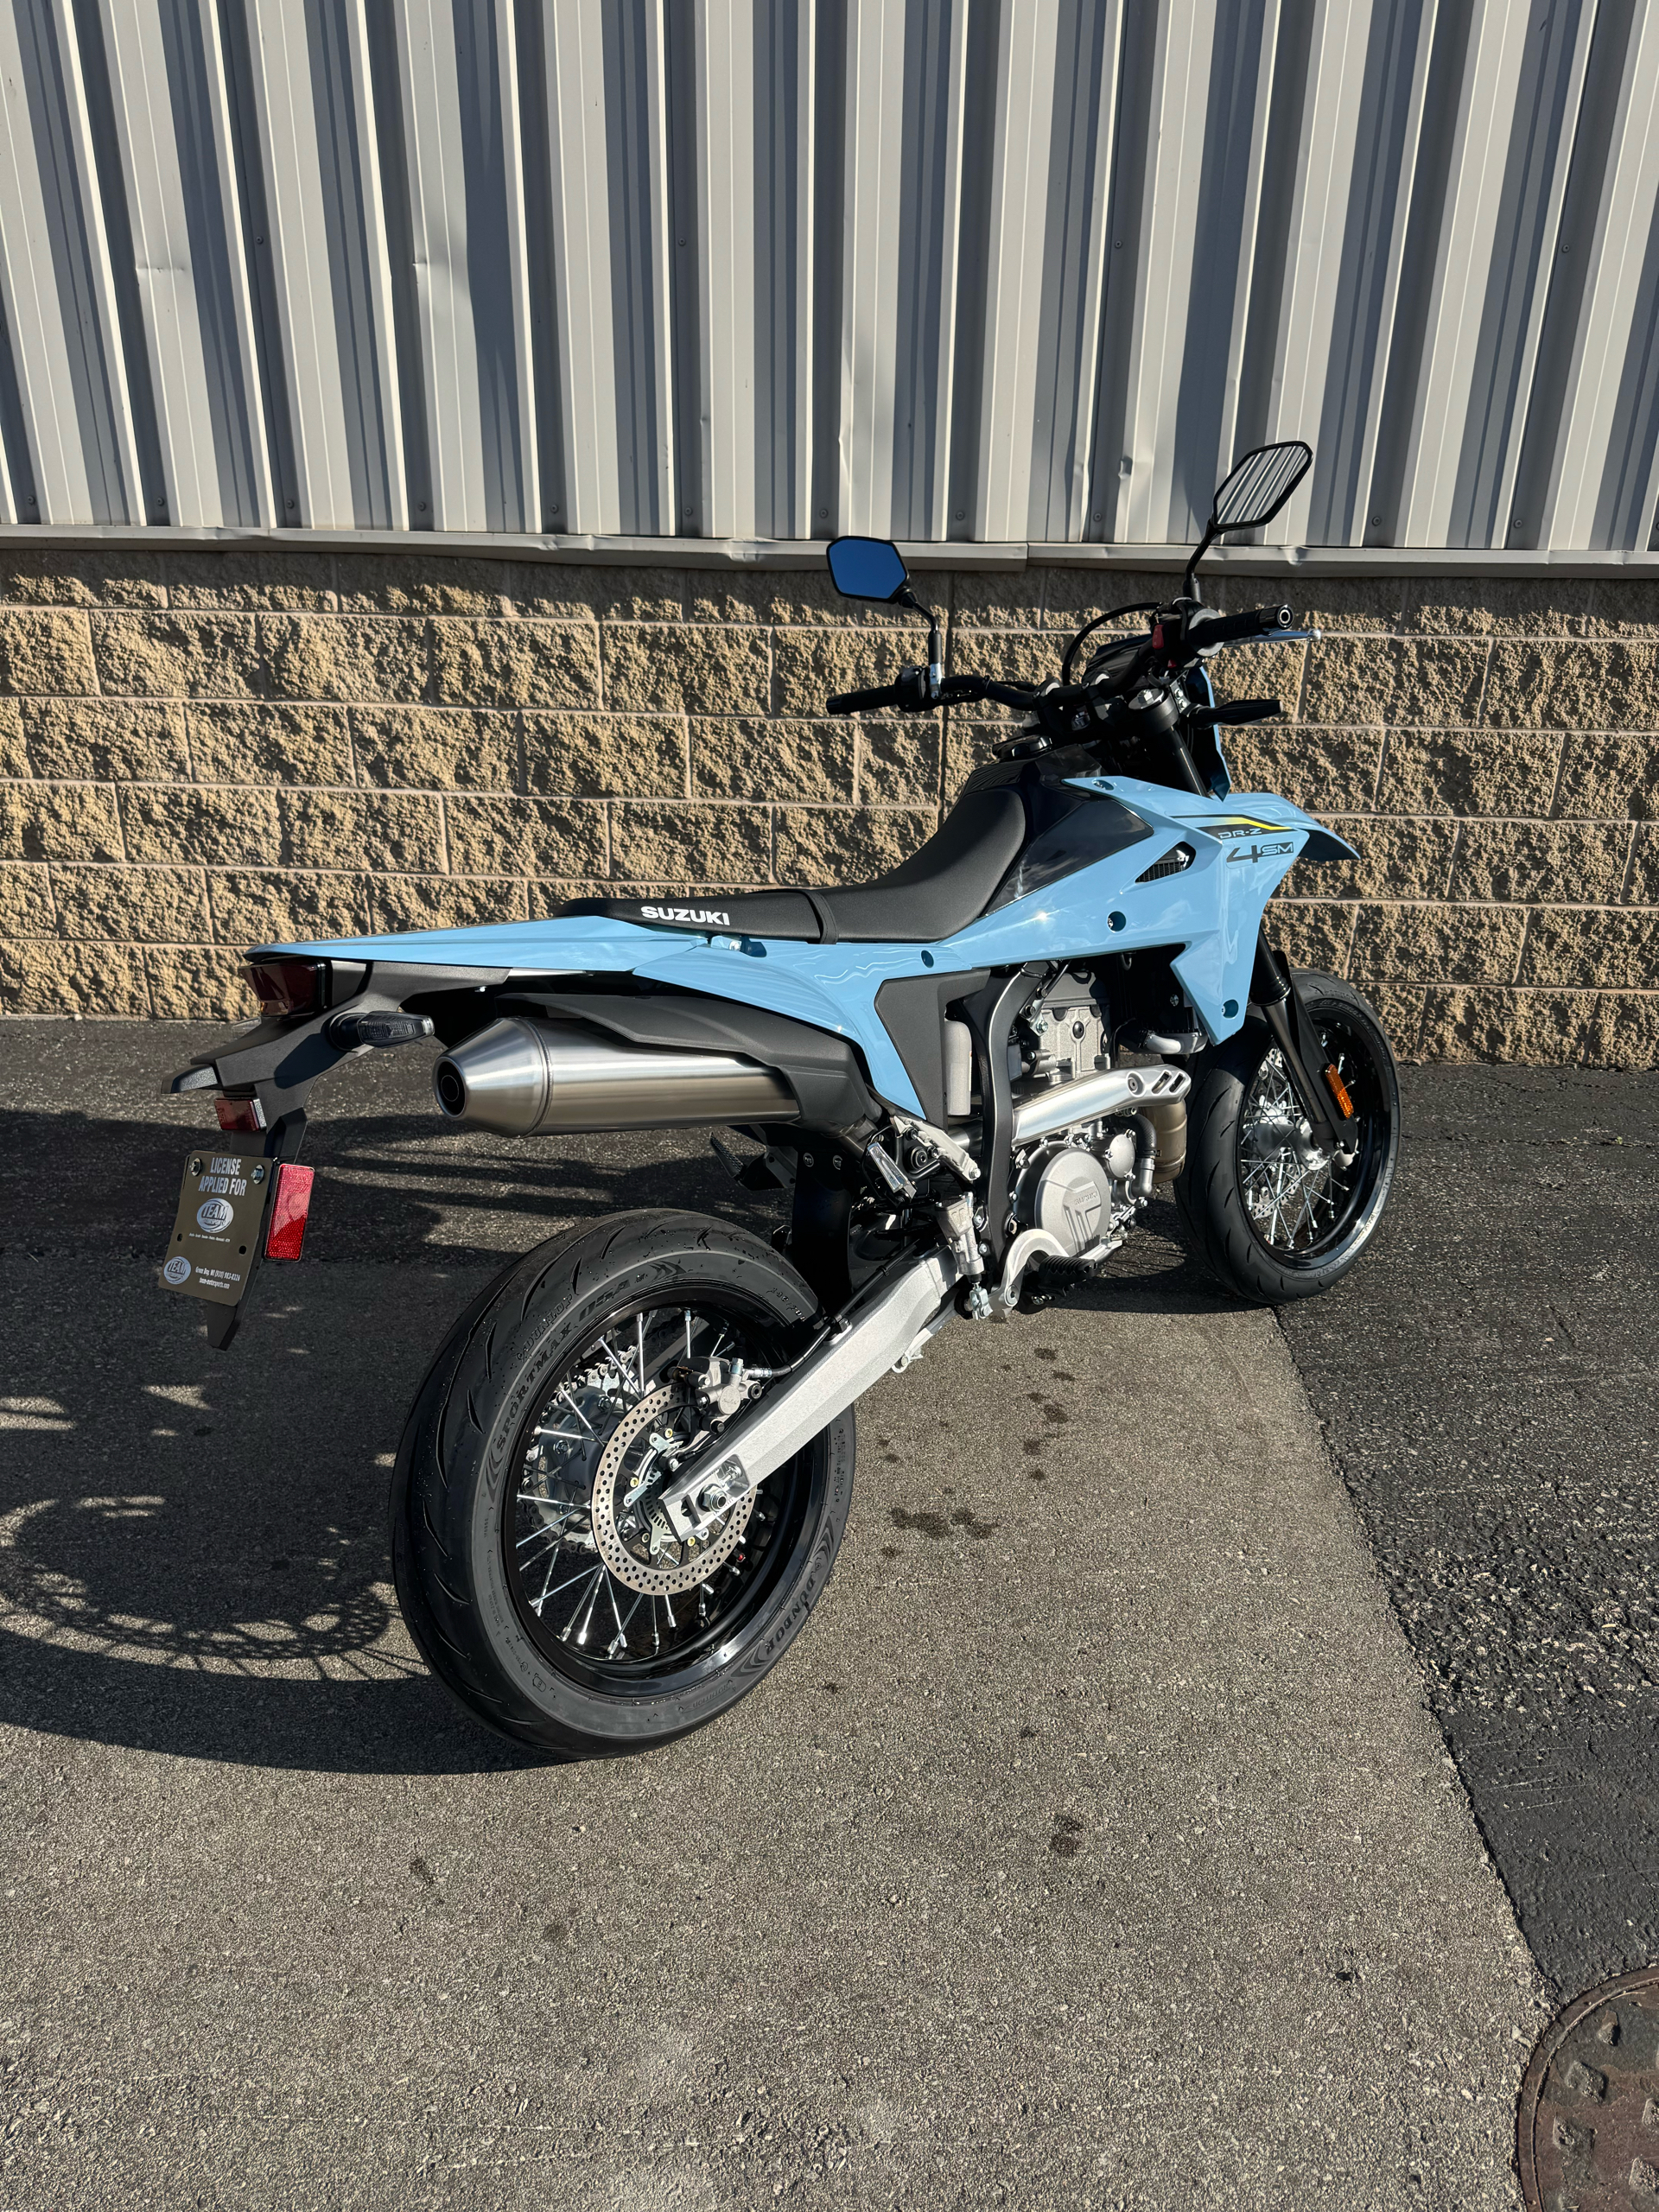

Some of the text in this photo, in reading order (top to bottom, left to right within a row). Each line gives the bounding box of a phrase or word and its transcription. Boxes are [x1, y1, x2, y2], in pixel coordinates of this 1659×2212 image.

[1217, 827, 1262, 840] DR-Z
[640, 906, 731, 926] SUZUKI
[209, 1157, 242, 1176] LICENSE
[198, 1175, 247, 1197] APPLIED FOR
[202, 1204, 230, 1220] TEAM
[168, 1261, 187, 1275] TEAM
[496, 1321, 572, 1453] SPORTMAX
